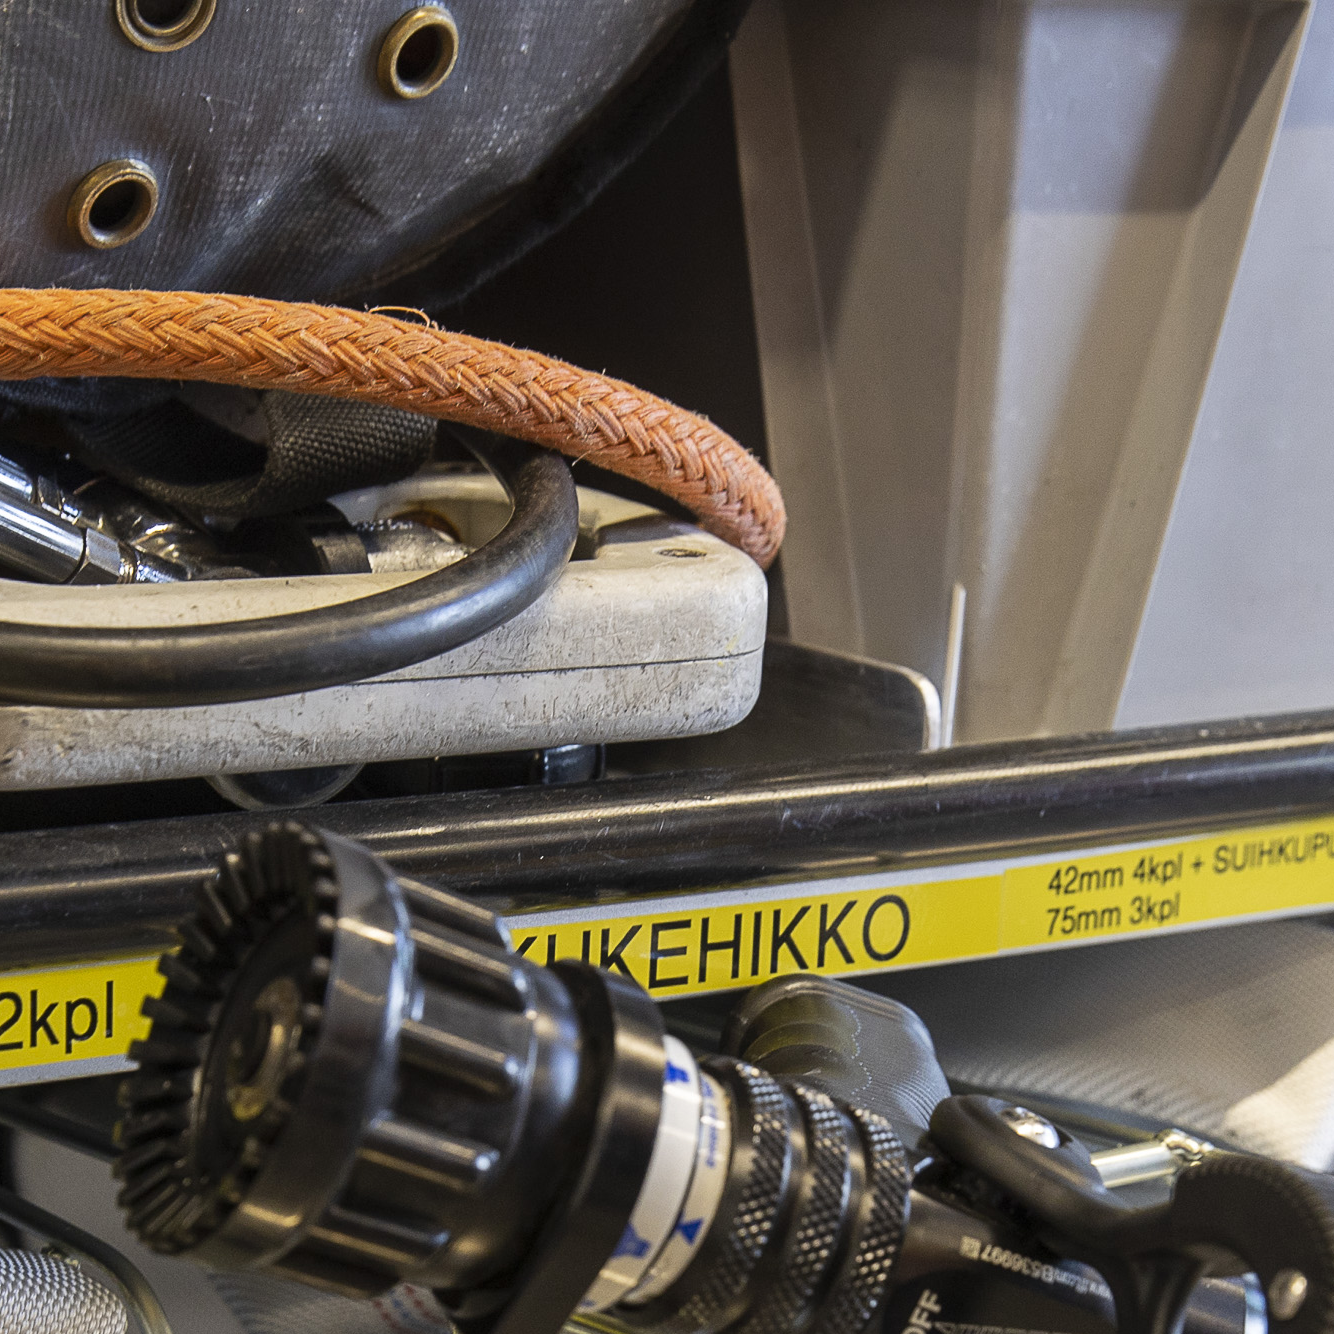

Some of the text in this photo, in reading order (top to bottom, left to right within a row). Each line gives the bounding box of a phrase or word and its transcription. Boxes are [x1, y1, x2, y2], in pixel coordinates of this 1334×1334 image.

[1048, 865, 1124, 897] 42mm
[1133, 851, 1183, 885] 4kpl
[1190, 856, 1206, 874] +
[1047, 892, 1181, 936] 75mm 3kpl
[514, 894, 910, 990] KEHIKKO
